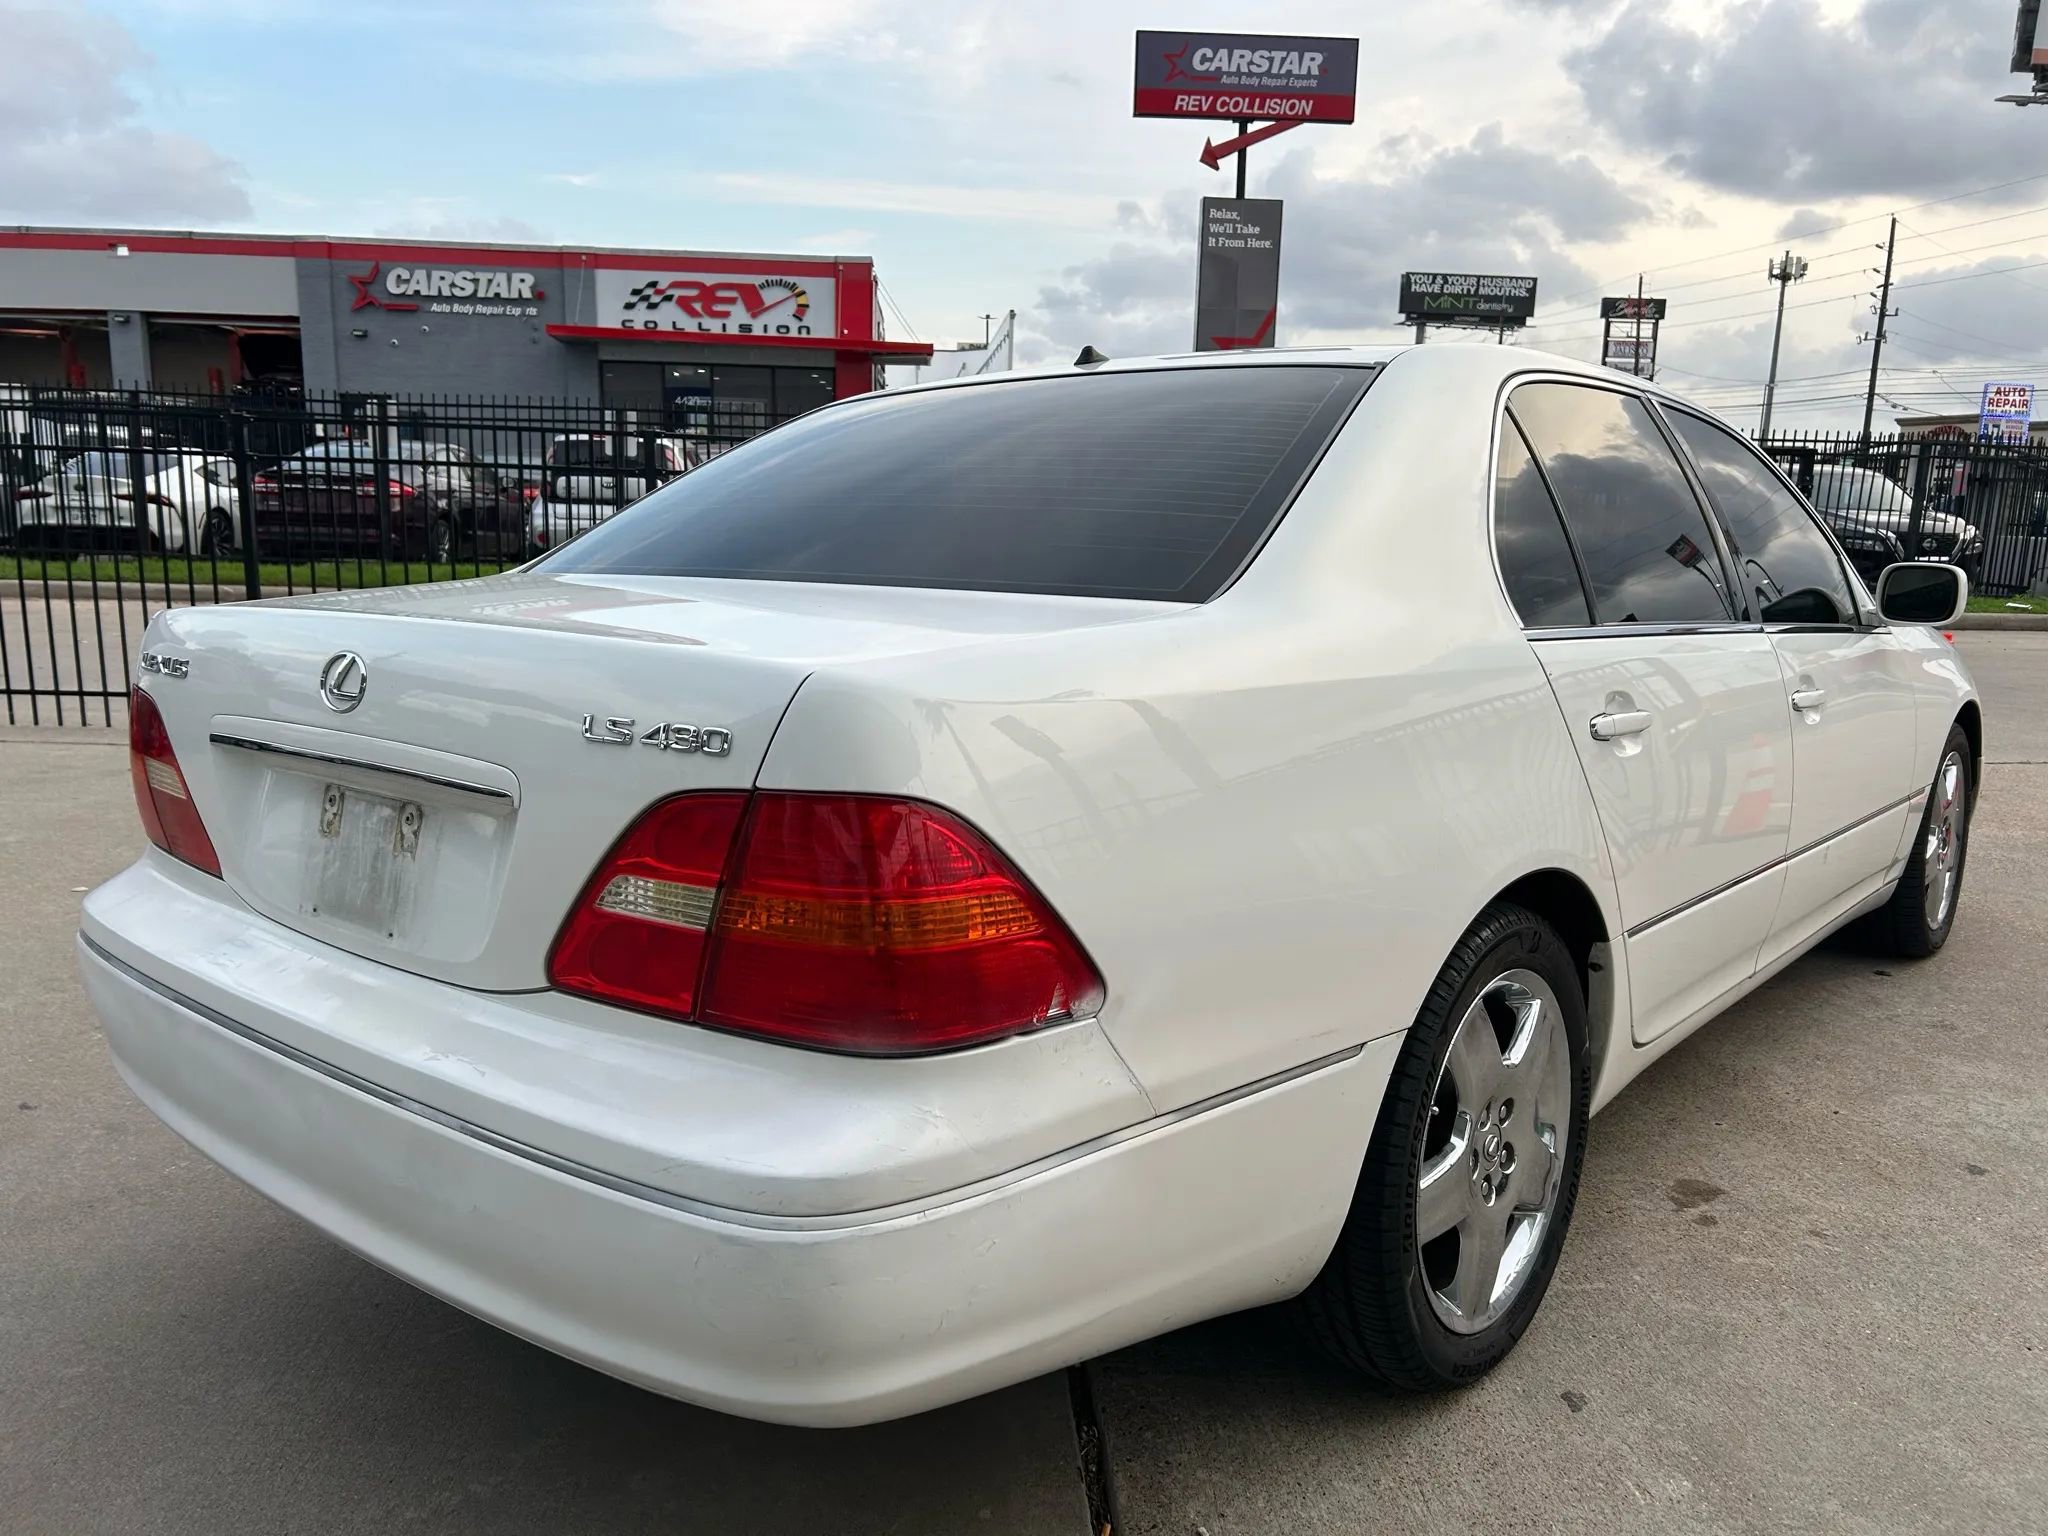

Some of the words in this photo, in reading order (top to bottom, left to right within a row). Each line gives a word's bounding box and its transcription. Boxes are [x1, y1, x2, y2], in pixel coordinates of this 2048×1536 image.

[1192, 47, 1324, 75] CARSTAR
[1220, 74, 1239, 85] Auto
[1240, 75, 1259, 87] Body
[1261, 76, 1287, 88] Repair
[1288, 77, 1318, 88] Experts
[1174, 95, 1213, 112] REV
[1215, 96, 1313, 116] COLLISION
[1209, 208, 1240, 220] Relax,
[1208, 223, 1233, 234] We'll
[1235, 224, 1260, 234] Take
[1208, 237, 1216, 247] It
[1218, 237, 1245, 248] From
[386, 267, 535, 299] CARSTAR
[1409, 274, 1433, 284] YOU
[1435, 274, 1444, 284] &
[1447, 276, 1477, 286] YOUR
[1480, 277, 1533, 289] HUSBAND
[1411, 283, 1440, 293] HAVE
[1443, 285, 1477, 295] DIRTY
[653, 280, 767, 320] REV
[431, 303, 451, 313] Auto
[453, 303, 474, 315] Body
[475, 304, 504, 316] Repair
[506, 305, 538, 316] Exprts
[621, 319, 811, 336] COLLISION
[1994, 387, 2026, 397] AUTO
[1988, 398, 2029, 408] REPAIR
[583, 713, 635, 745] LS
[639, 722, 732, 757] 430
